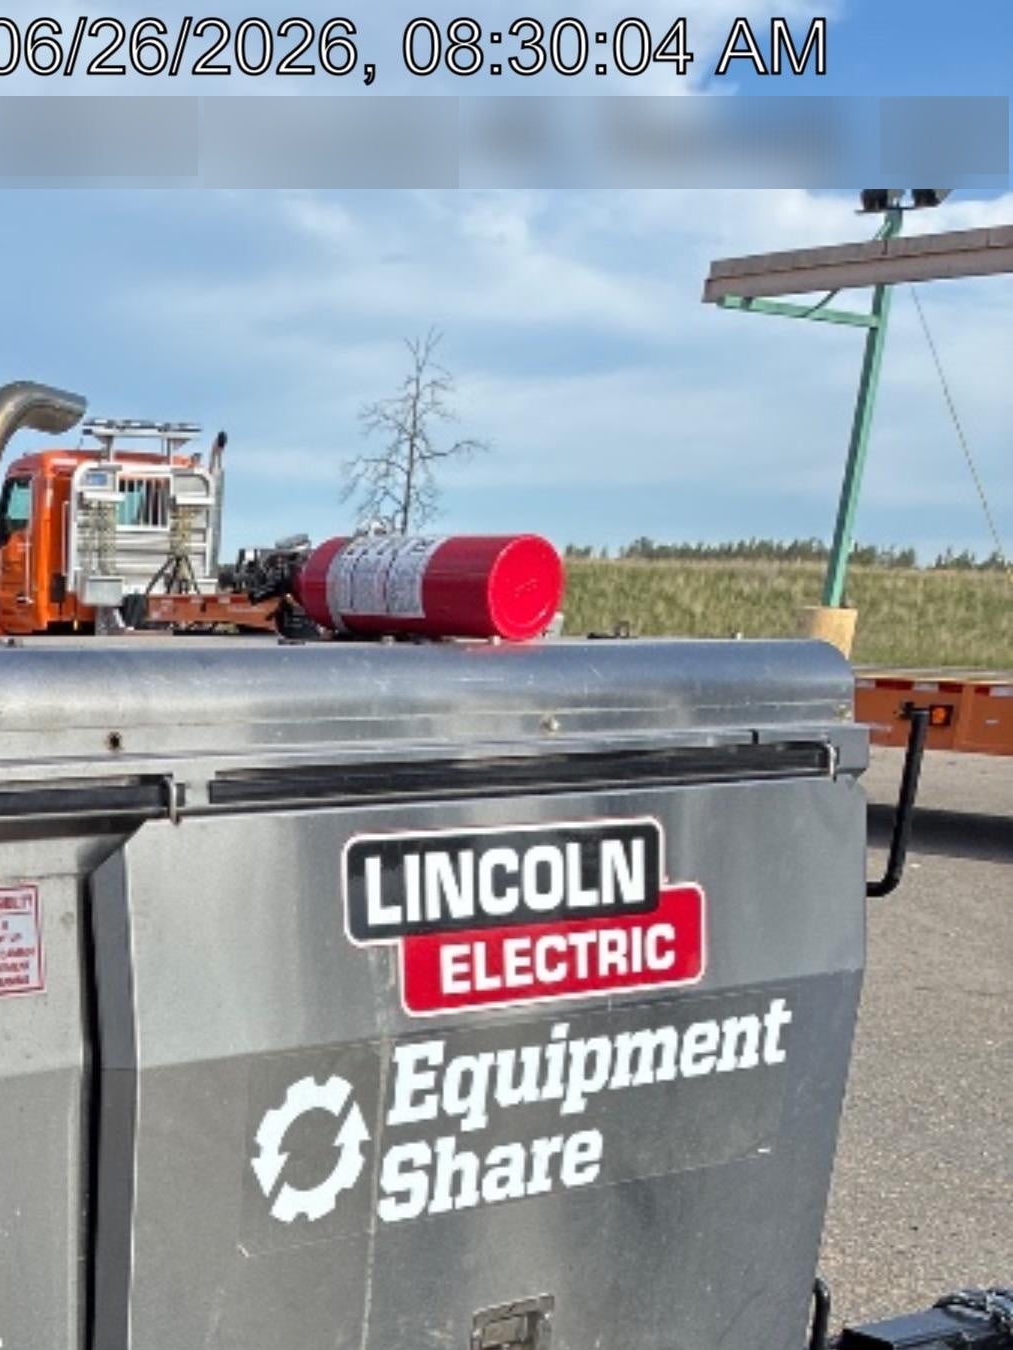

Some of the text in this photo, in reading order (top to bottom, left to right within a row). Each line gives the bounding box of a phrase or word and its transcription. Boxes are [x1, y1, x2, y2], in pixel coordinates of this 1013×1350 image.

[364, 838, 646, 927] LINCOLN
[440, 922, 677, 996] ELECTRIC
[386, 998, 792, 1132] Equipment
[376, 1127, 604, 1223] Share
